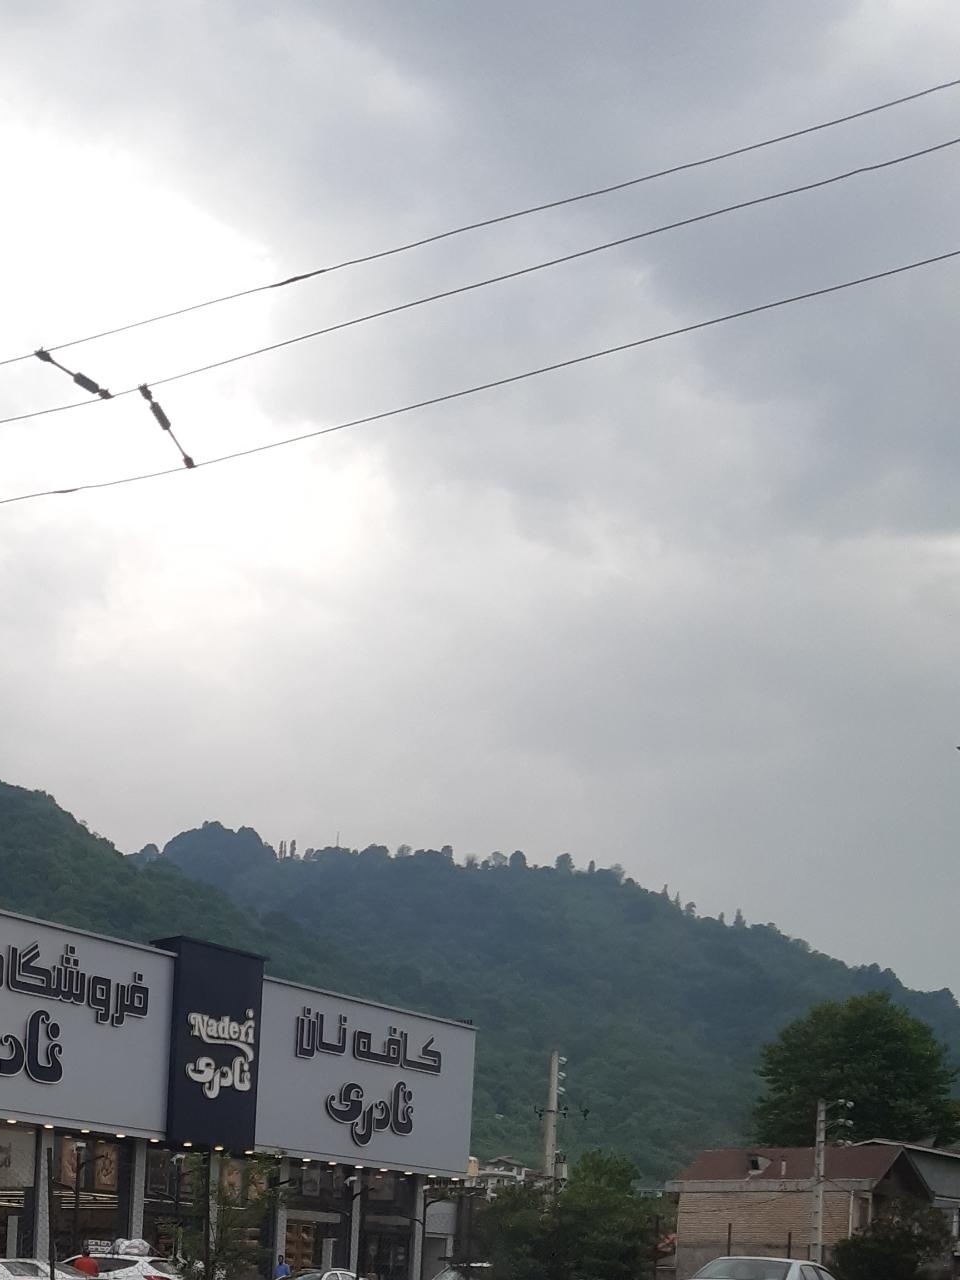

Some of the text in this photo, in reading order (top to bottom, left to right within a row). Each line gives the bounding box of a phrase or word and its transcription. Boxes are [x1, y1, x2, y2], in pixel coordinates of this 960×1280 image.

[187, 1008, 255, 1062] Naderi
[295, 1006, 442, 1075] کافه نان
[185, 1055, 251, 1099] نادری
[325, 1080, 414, 1146] نادری
